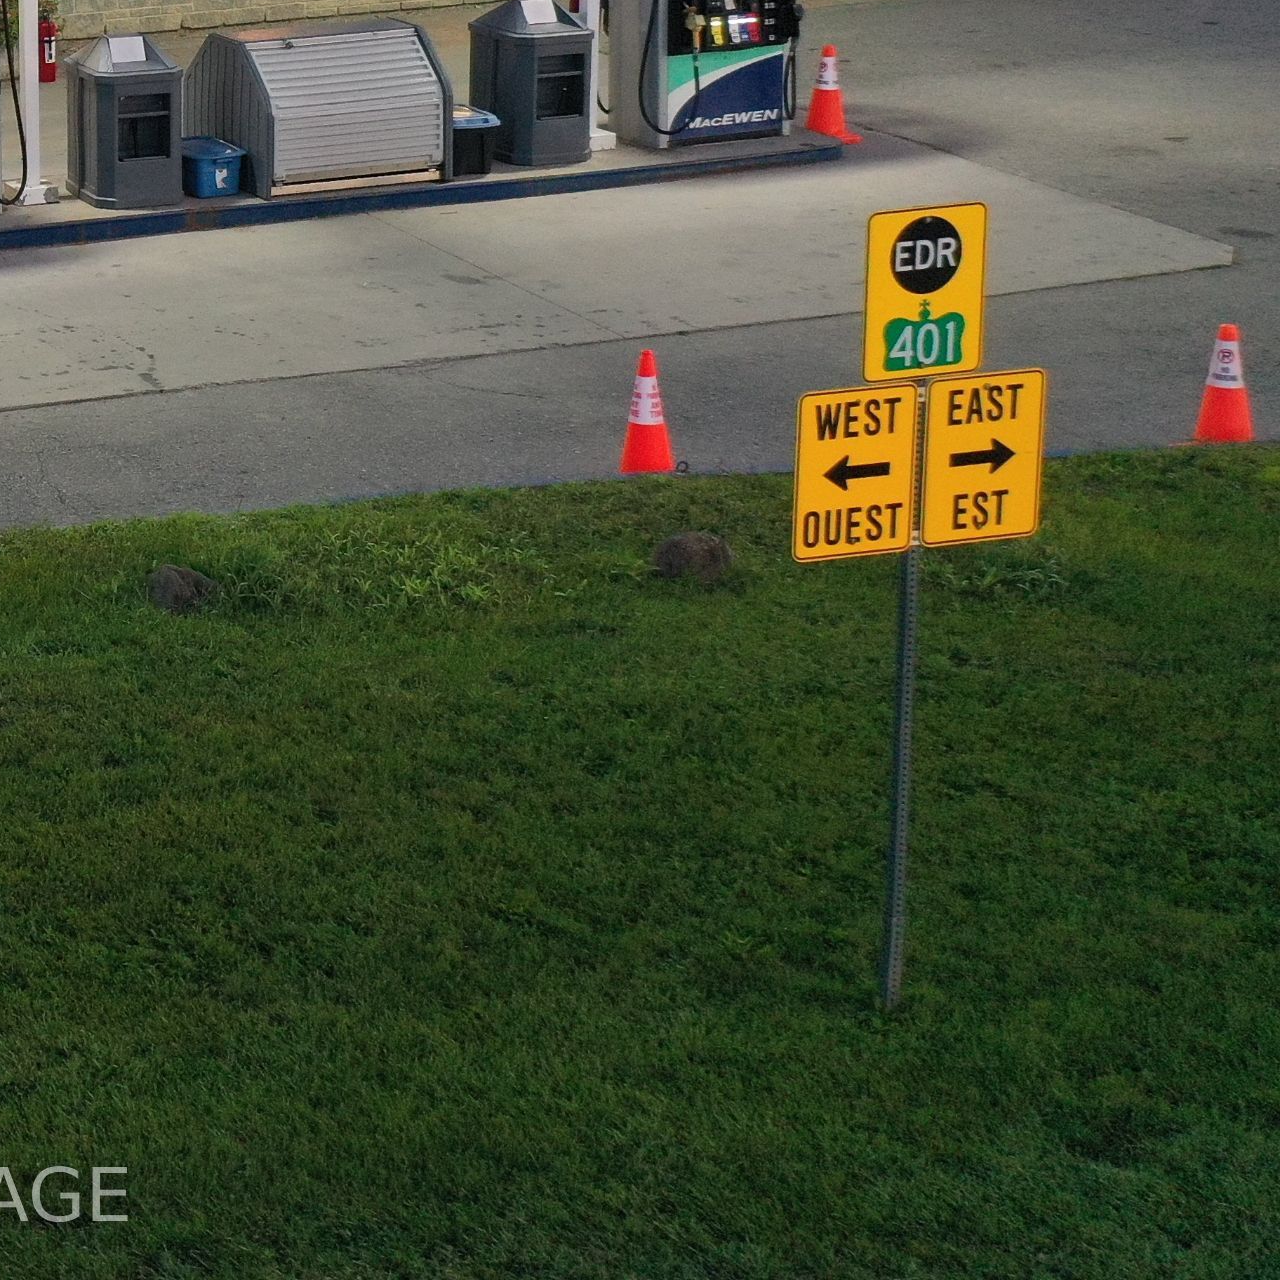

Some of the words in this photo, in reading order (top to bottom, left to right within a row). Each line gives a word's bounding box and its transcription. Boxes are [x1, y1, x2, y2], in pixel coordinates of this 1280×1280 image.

[895, 236, 957, 272] EDR
[890, 321, 955, 367] 401
[815, 397, 902, 441] WEST
[947, 383, 1024, 426] EAST
[803, 502, 903, 549] OUEST
[952, 489, 1009, 530] EST
